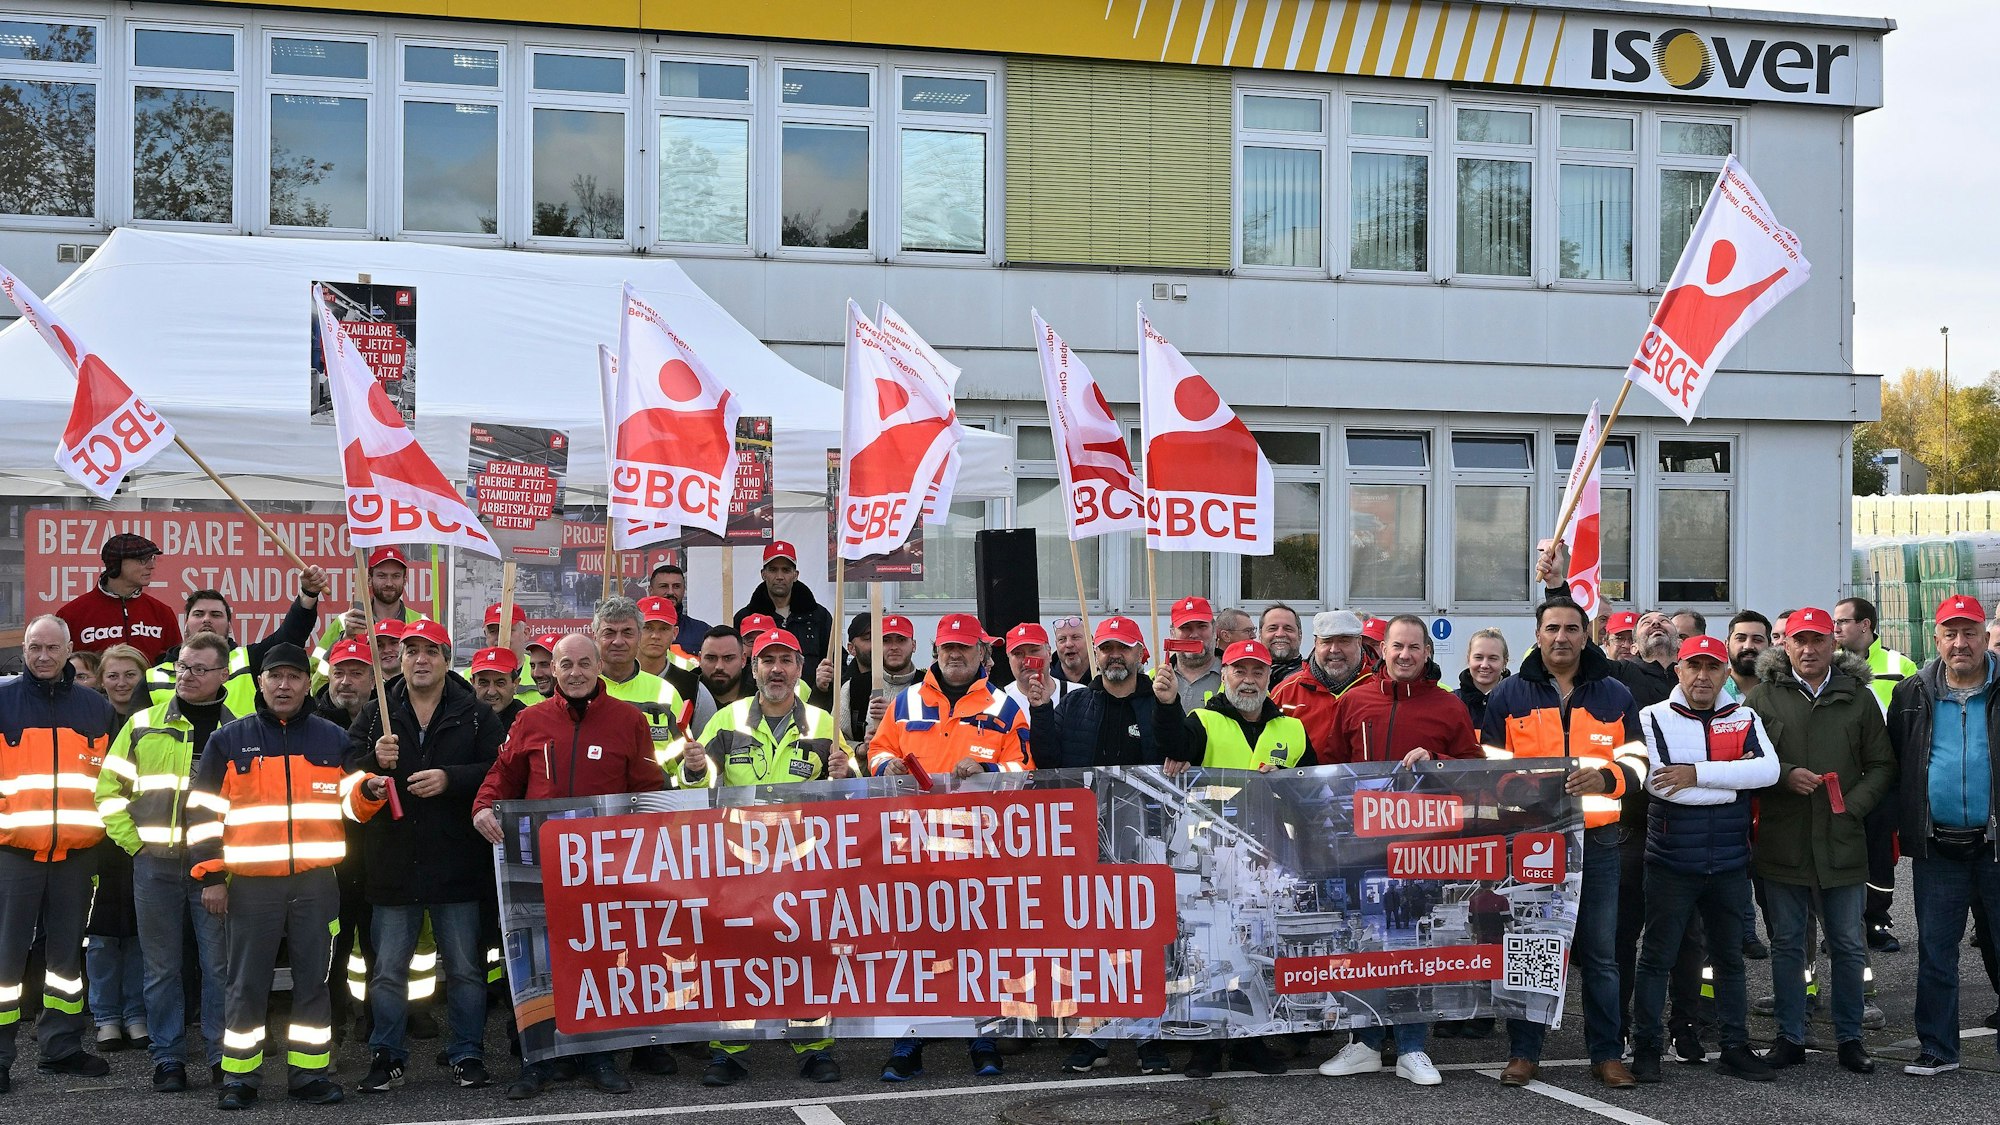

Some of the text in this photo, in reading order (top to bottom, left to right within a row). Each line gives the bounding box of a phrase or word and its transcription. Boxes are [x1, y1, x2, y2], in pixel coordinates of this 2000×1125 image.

[1741, 205, 1771, 234] Chemie,
[365, 339, 393, 351] JETZT
[382, 353, 402, 365] UND
[490, 463, 545, 478] BEZAHLBARE
[480, 476, 516, 488] ENERGIE
[519, 480, 546, 491] JETZT
[743, 478, 760, 488] UND
[480, 489, 552, 504] STANDORTE UND
[481, 503, 549, 517] ARBEITSPLÄTZE
[495, 516, 532, 528] RETTEN!
[1362, 796, 1458, 831] PROJEKT
[558, 802, 1076, 887] BEZAHLBARE ENERGIE
[1392, 841, 1498, 874] ZUKUNFT
[1522, 868, 1554, 879] IGBCE
[568, 897, 709, 952] JETZT
[773, 875, 1044, 943] STANDORTE
[1063, 874, 1156, 930] UND
[1284, 954, 1492, 986] projektzukunft.igbce.de
[575, 944, 1143, 1021] ARBEITSPLÄTZE RETTEN!
